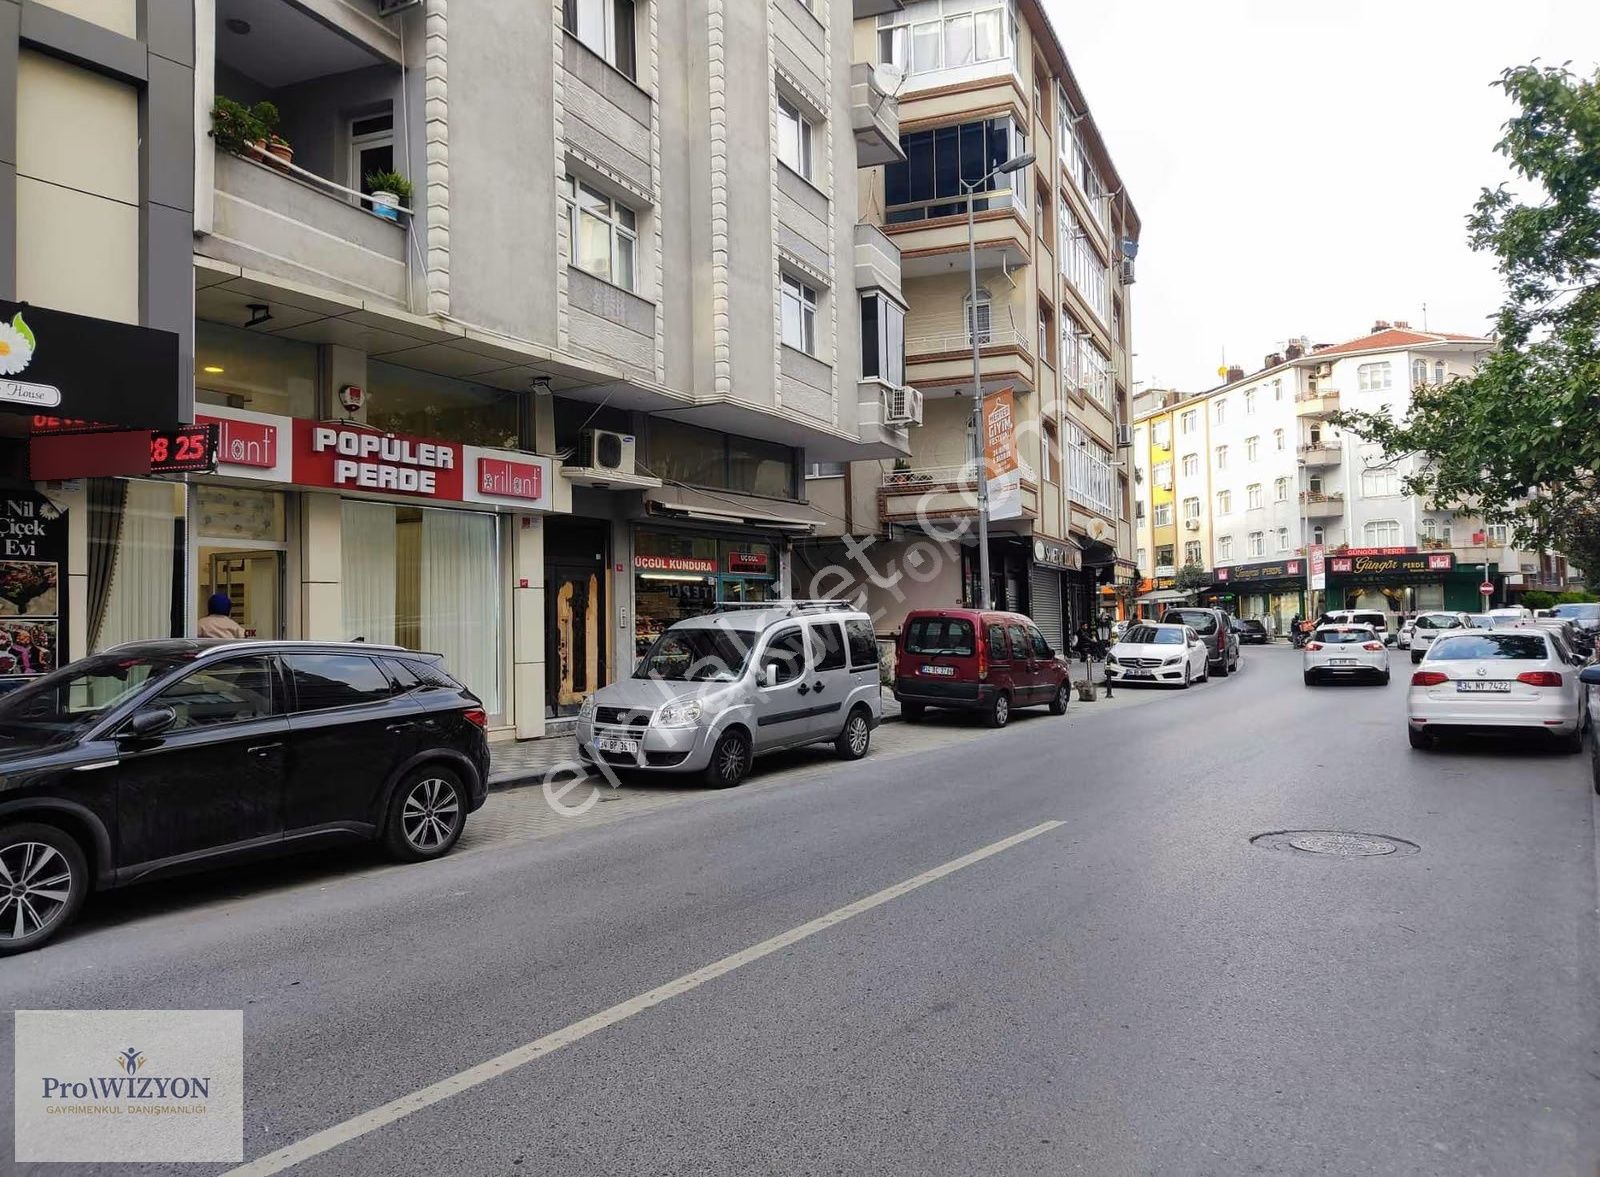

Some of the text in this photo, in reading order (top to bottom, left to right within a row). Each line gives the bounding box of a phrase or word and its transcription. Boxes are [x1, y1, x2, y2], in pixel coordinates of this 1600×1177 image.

[151, 434, 204, 462] 8 25
[312, 427, 454, 469] POPÜLER
[334, 460, 436, 494] PERDE
[483, 459, 539, 497] brillant
[7, 500, 34, 518] Nil
[0, 520, 46, 539] Çiçek
[5, 539, 36, 556] Evi
[634, 556, 667, 568] ÜÇGÜL
[669, 560, 712, 571] KUNDURA
[1354, 556, 1397, 574] Güngör
[244, 628, 256, 639] ÇIK
[1463, 682, 1472, 690] 34
[1490, 682, 1508, 690] 7422
